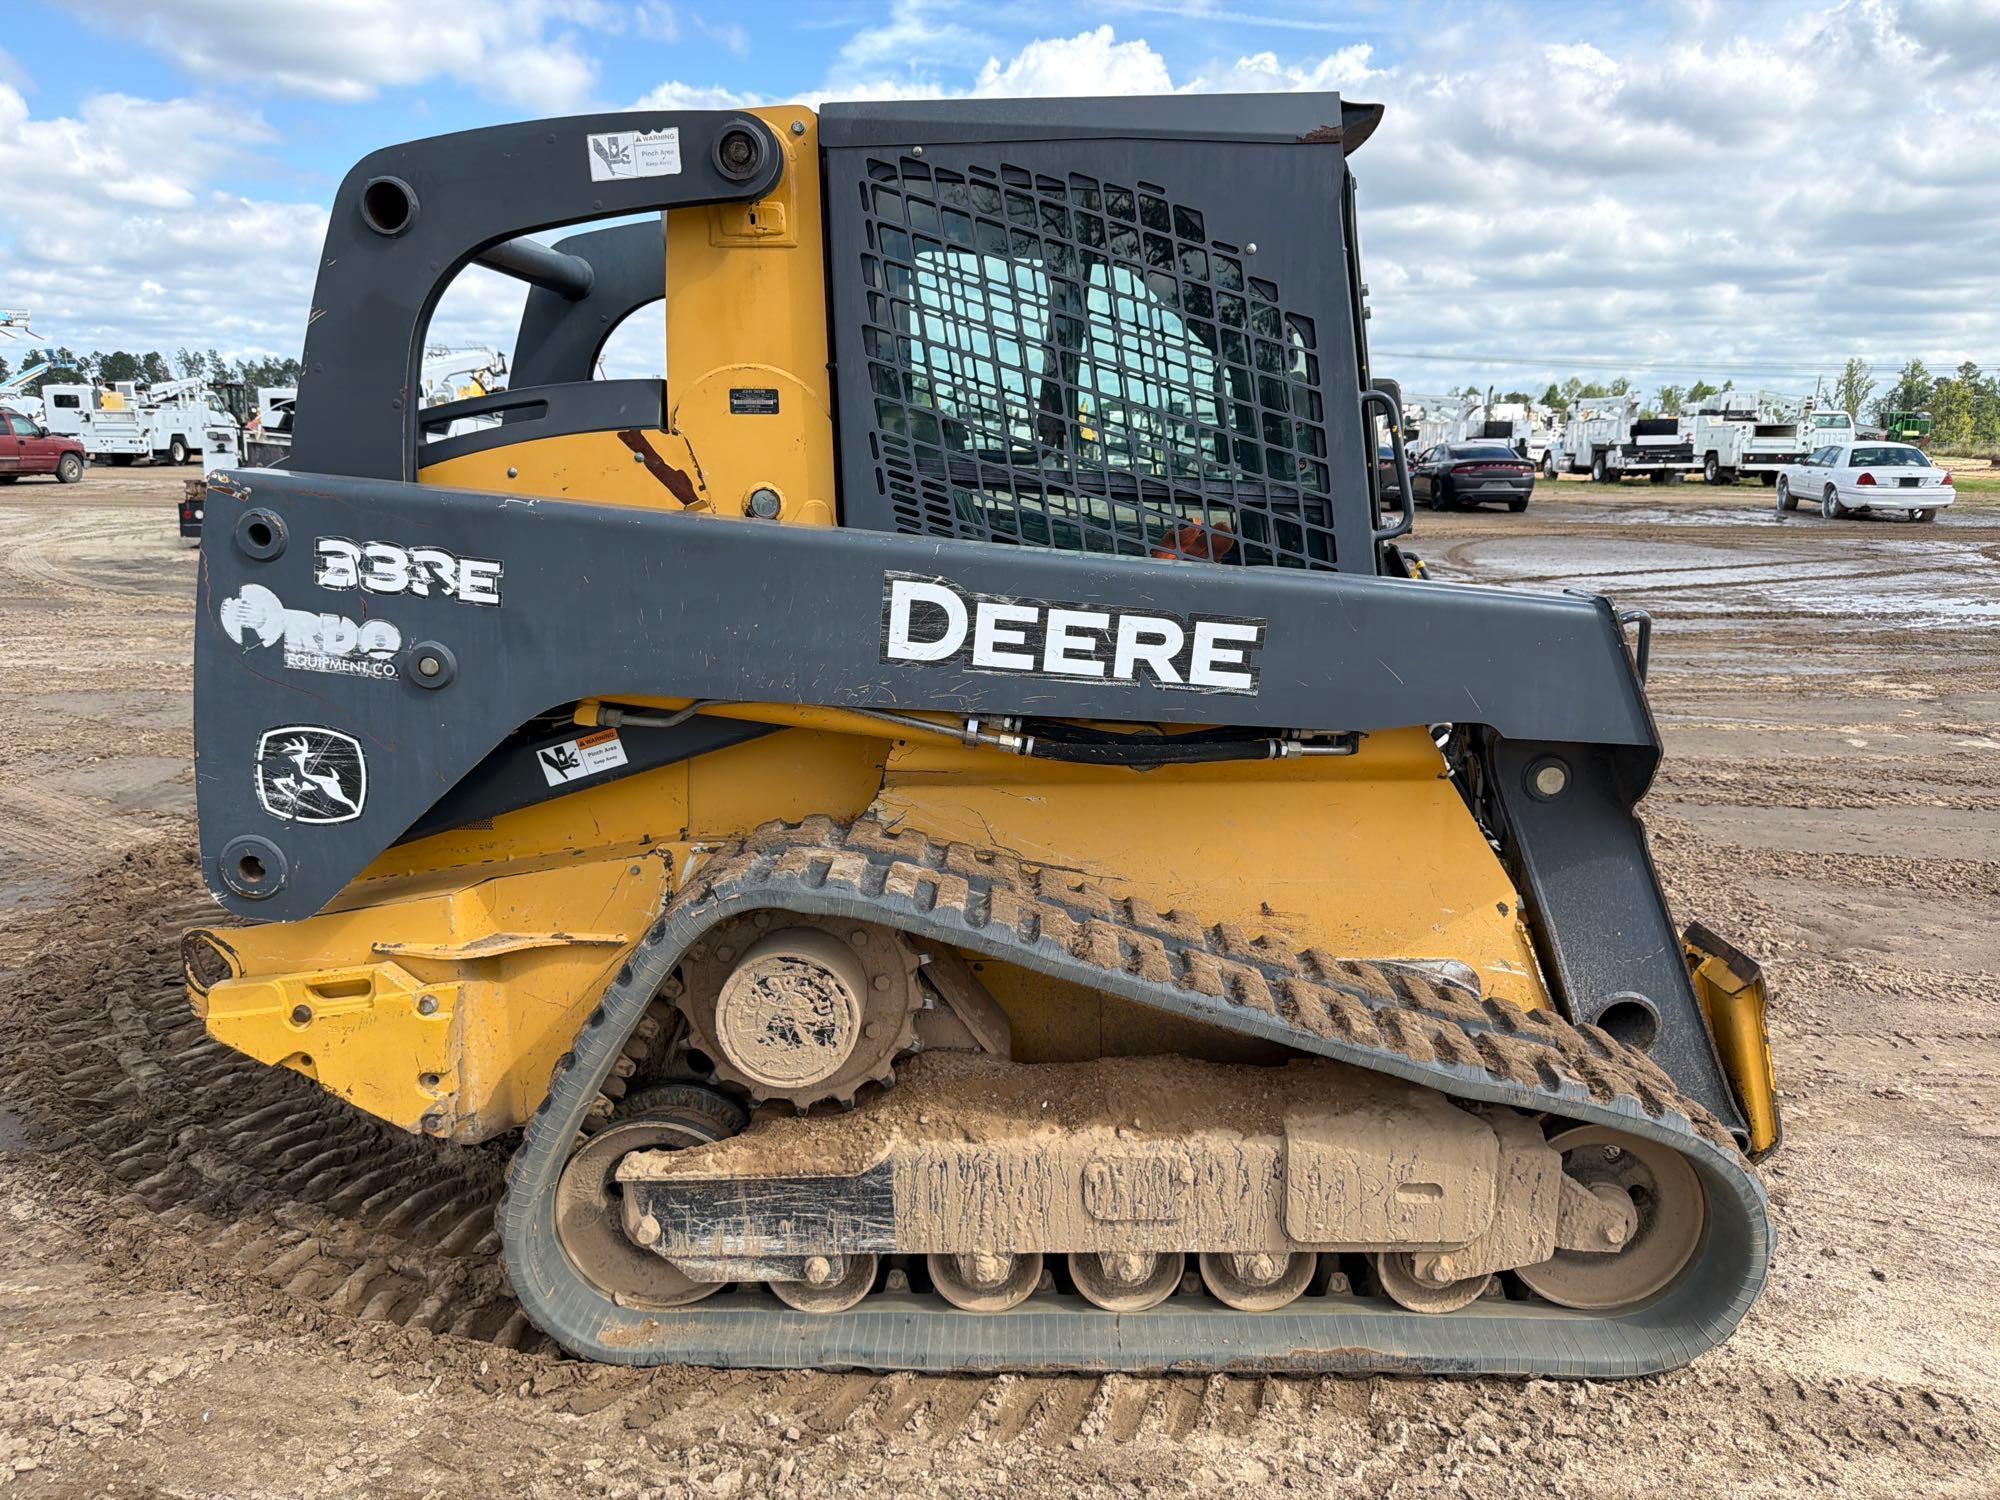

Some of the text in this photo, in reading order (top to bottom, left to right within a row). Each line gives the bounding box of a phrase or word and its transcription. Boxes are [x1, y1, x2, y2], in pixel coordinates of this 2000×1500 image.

[642, 133, 675, 142] WARNING
[642, 148, 674, 157] Pinch Area
[888, 580, 1258, 688] DEERE
[287, 655, 399, 678] EQUIPMENT CO.
[588, 744, 617, 757] Pinch Area
